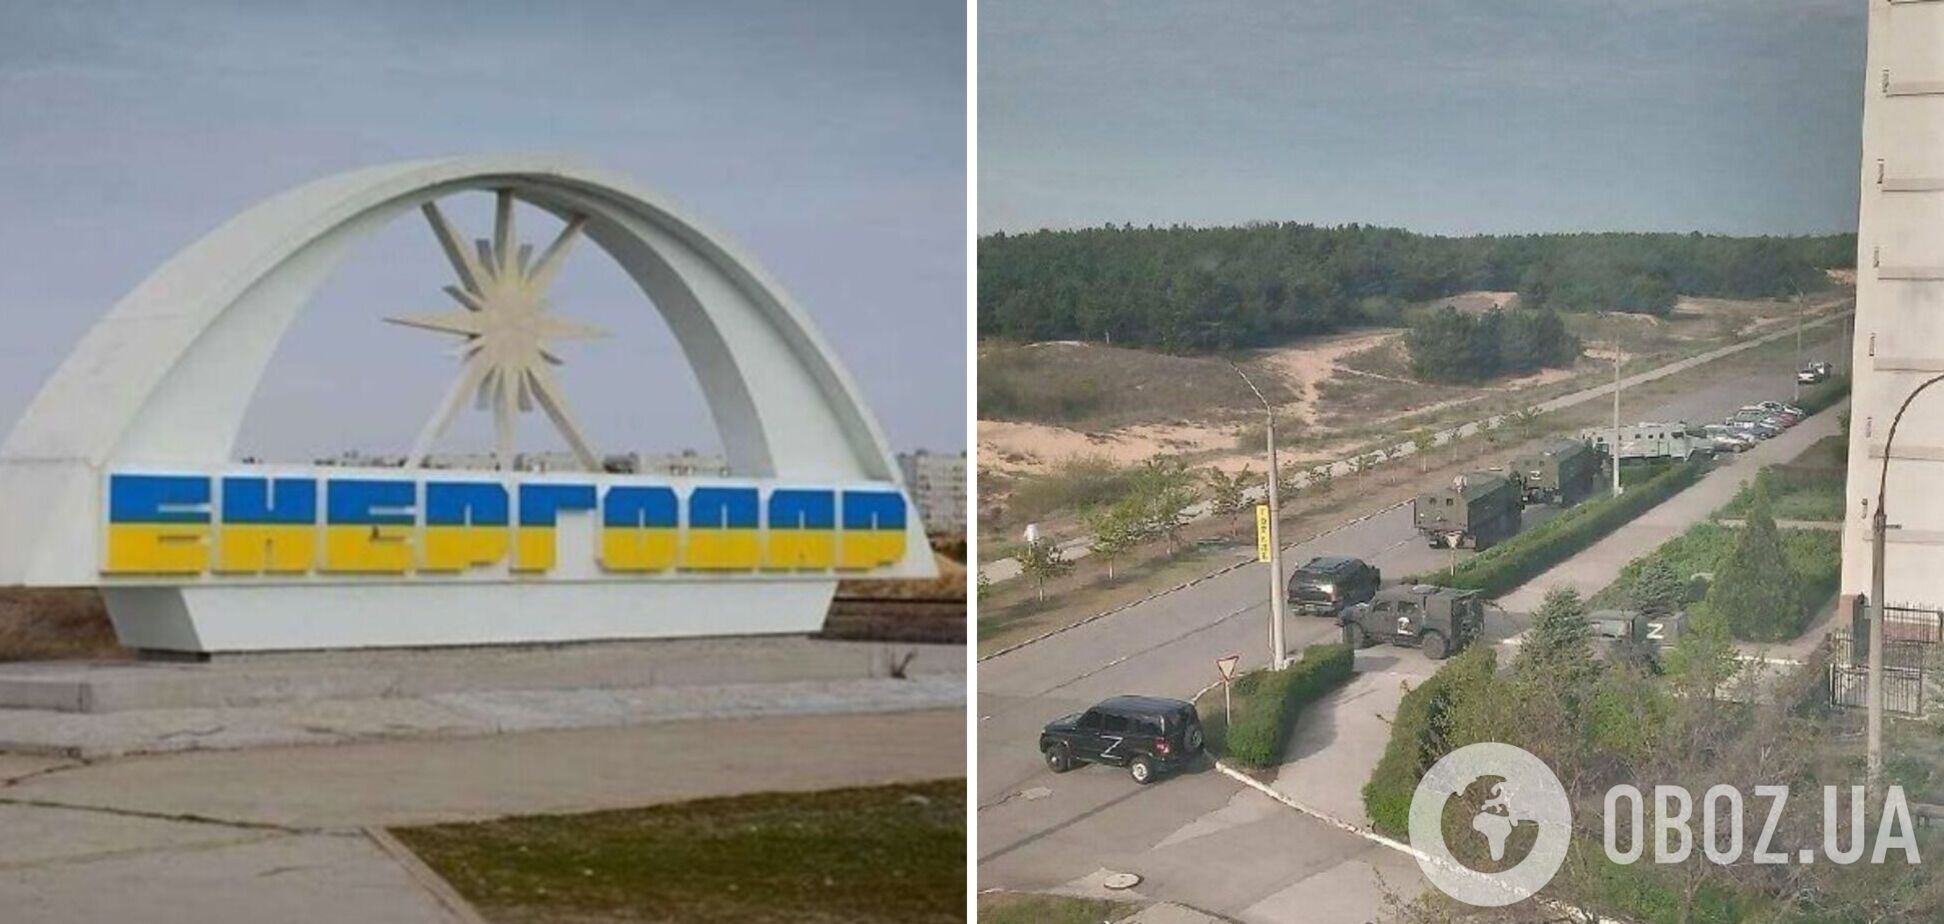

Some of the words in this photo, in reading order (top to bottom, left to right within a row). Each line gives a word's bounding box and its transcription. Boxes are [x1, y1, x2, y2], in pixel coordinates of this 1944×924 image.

[102, 475, 907, 574] ЕНЕРГОДАР
[1646, 622, 1664, 639] Z
[1100, 735, 1123, 759] Z
